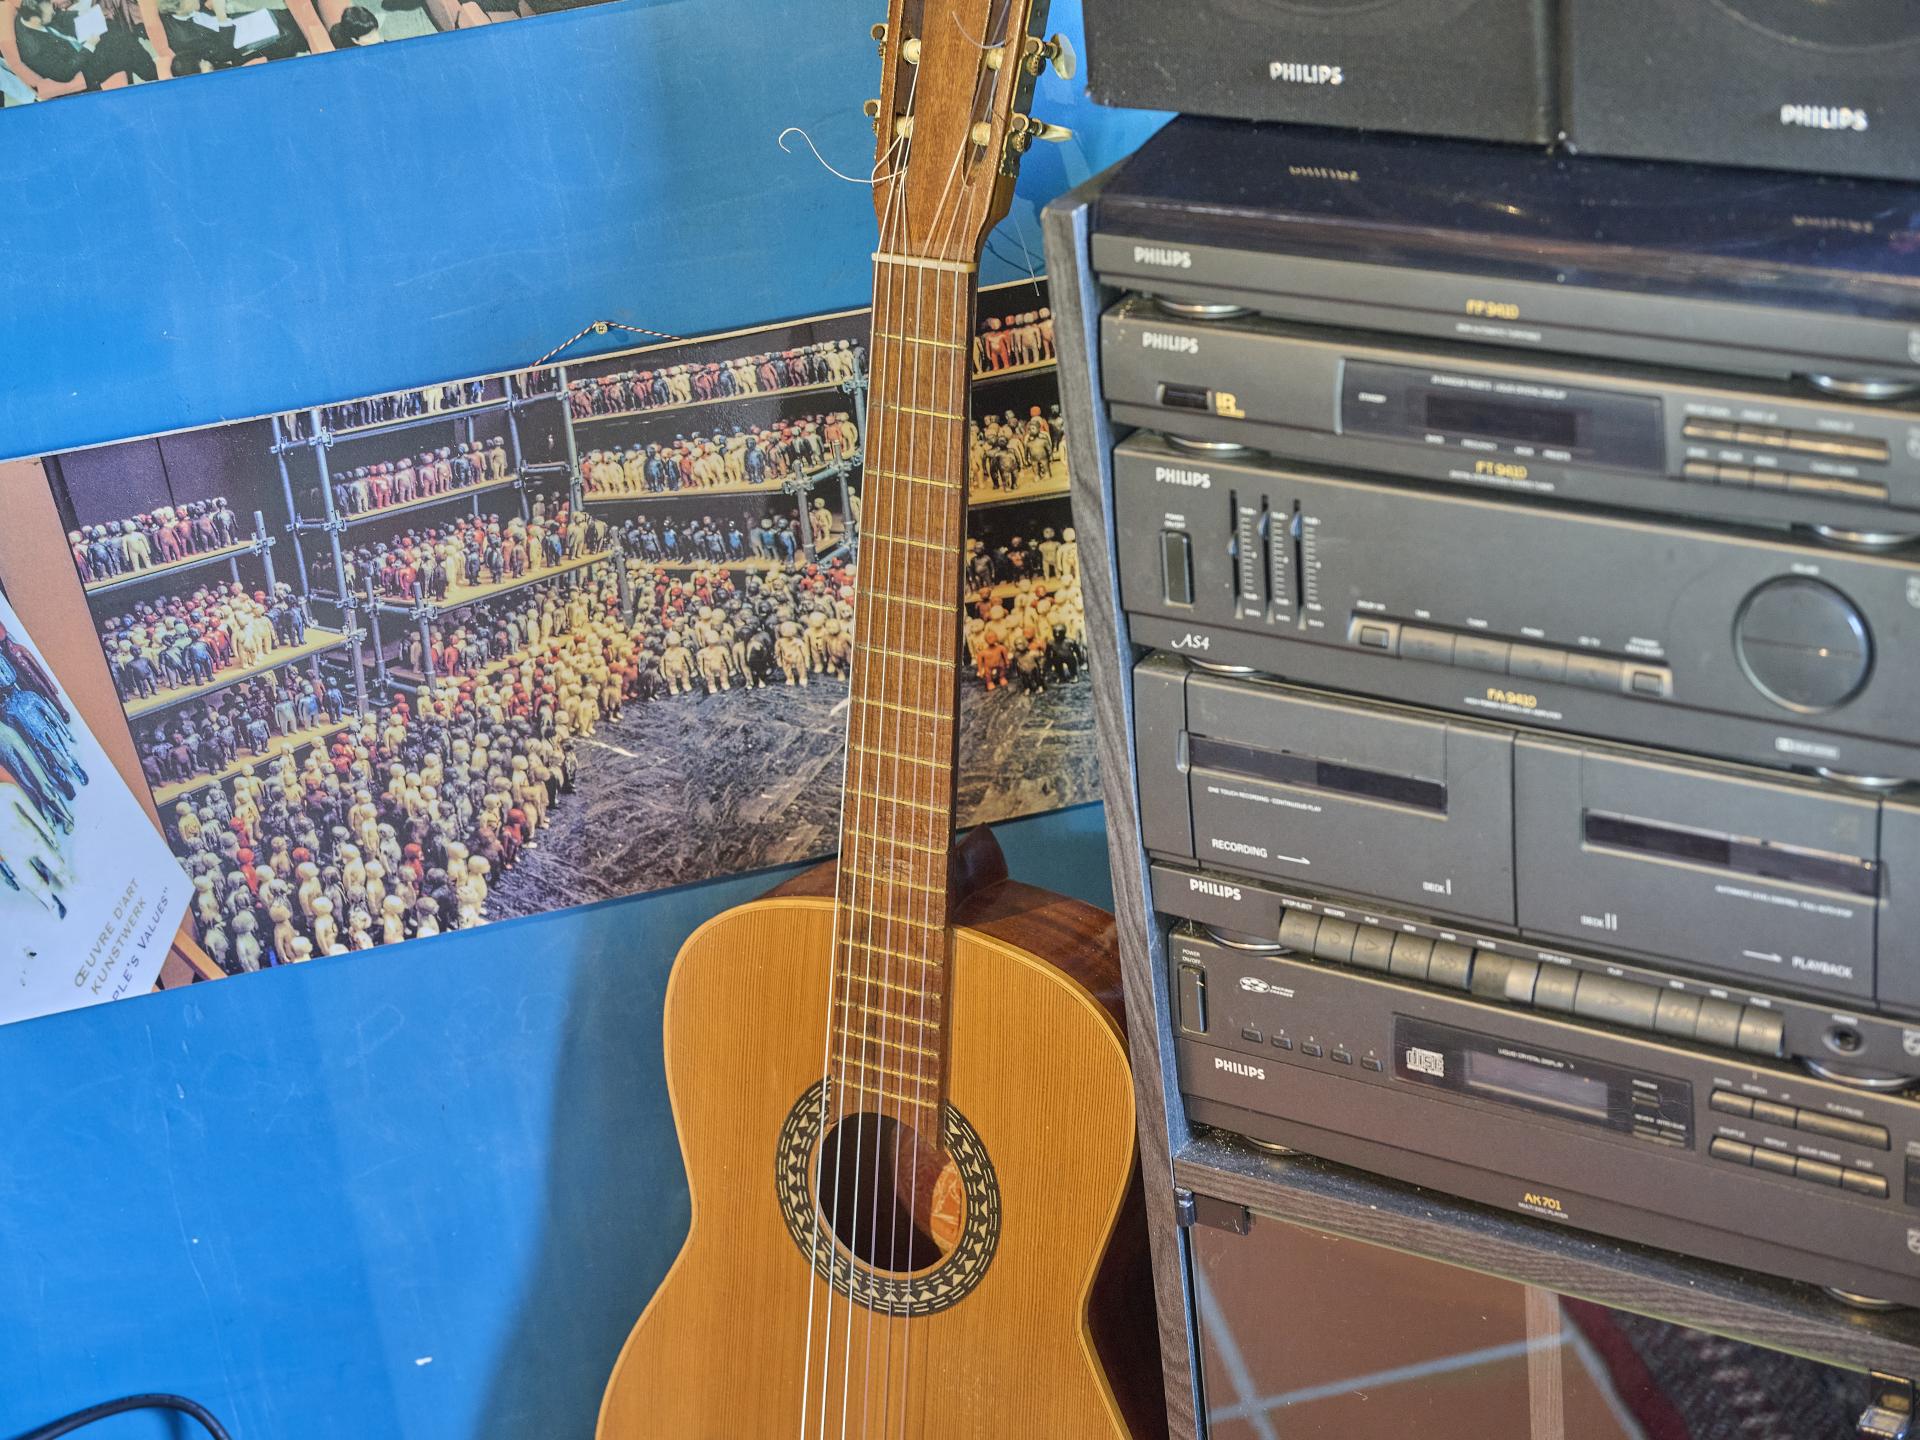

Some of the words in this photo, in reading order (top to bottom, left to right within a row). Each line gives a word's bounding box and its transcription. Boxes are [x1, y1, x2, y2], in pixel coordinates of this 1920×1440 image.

[1269, 61, 1345, 86] PHILIPS
[1780, 103, 1869, 132] PHILIPS
[1133, 246, 1192, 269] PHILIPS
[1142, 331, 1199, 355] PHILIPS
[1155, 466, 1212, 489] PHILIPS
[1211, 838, 1268, 859] RECORDING
[113, 877, 139, 920] D'ART
[1189, 878, 1242, 901] PHILIPS
[91, 895, 147, 995] KUNSTWERK
[1182, 948, 1201, 957] POWER
[1791, 955, 1853, 980] PLAYBACK
[1214, 1057, 1266, 1081] PHILIPS
